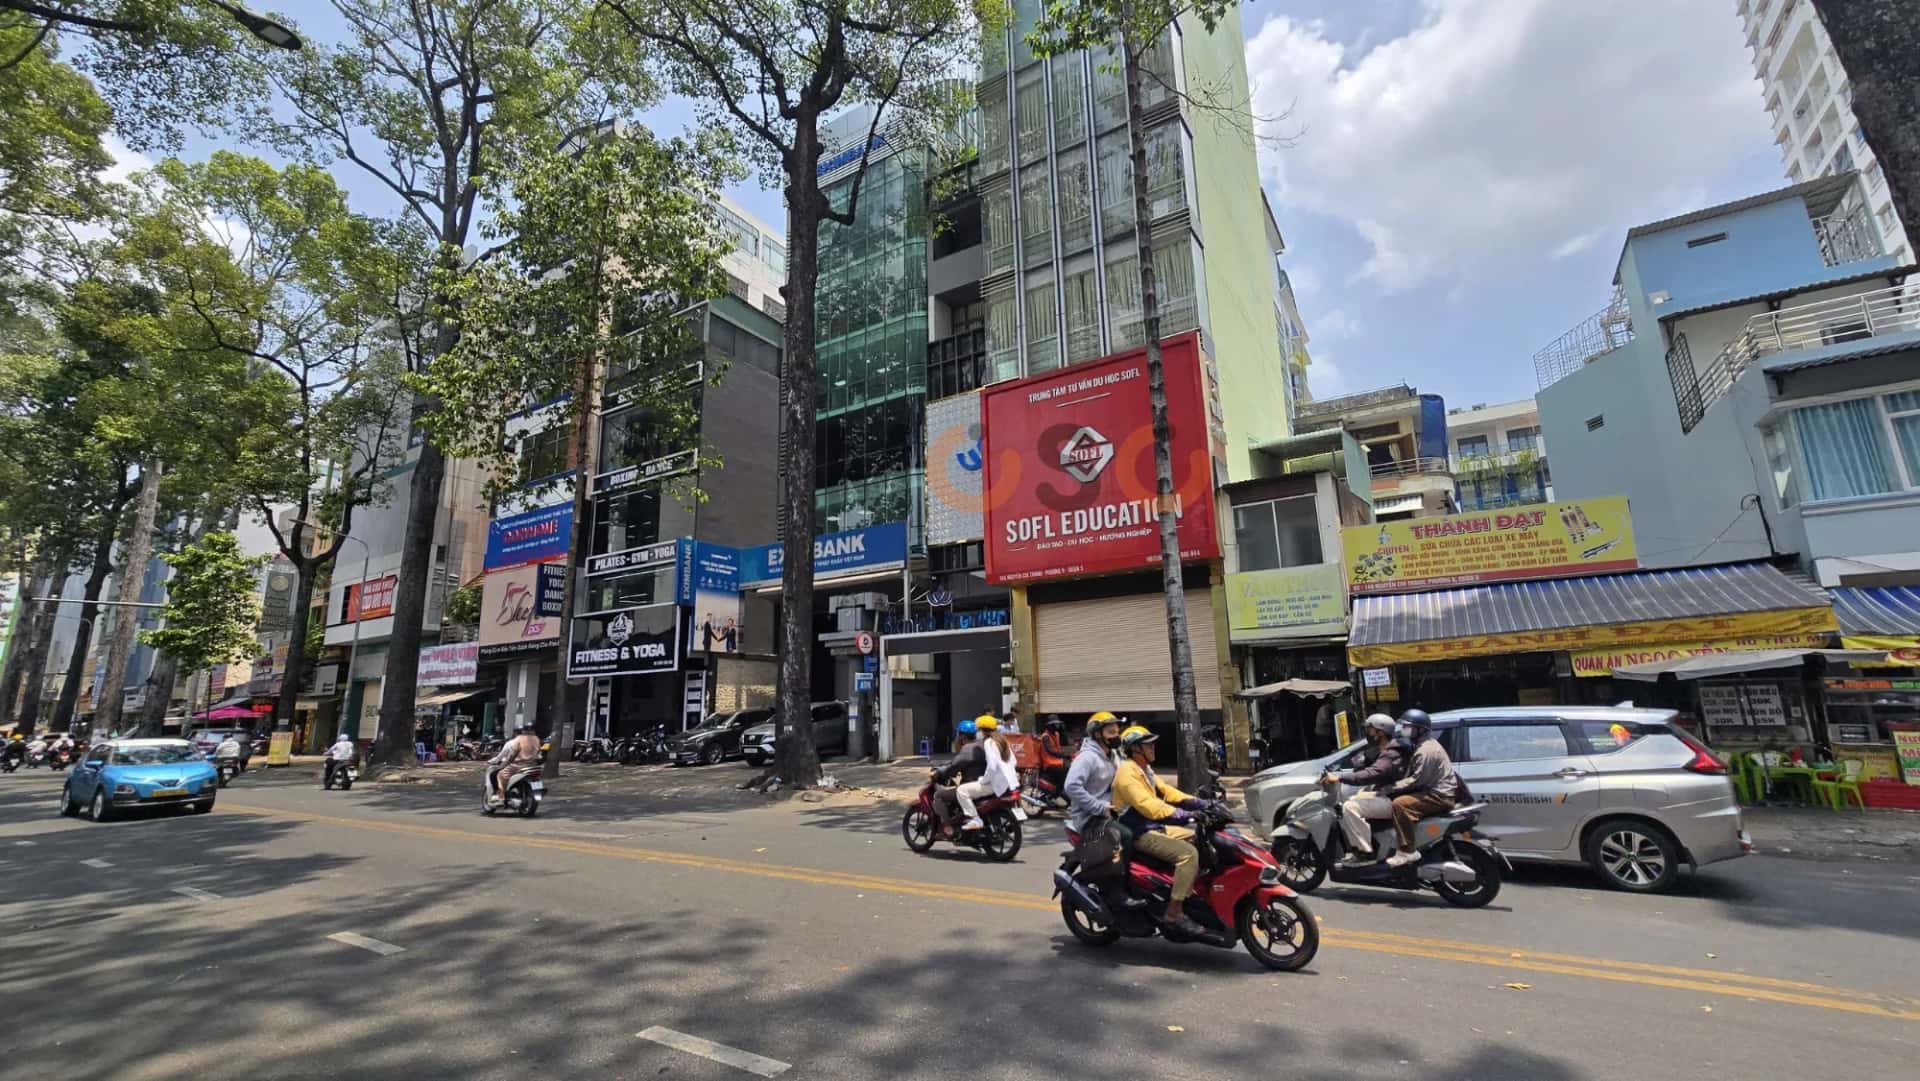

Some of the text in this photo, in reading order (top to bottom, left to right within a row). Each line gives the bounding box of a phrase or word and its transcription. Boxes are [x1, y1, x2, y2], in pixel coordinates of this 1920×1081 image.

[1029, 391, 1051, 403] TRUNG
[1093, 377, 1104, 388] DU
[1120, 368, 1140, 380] SOFL
[1006, 514, 1055, 544] SOFL
[1495, 510, 1546, 531] ĐẠT
[1505, 533, 1516, 542] XE
[594, 545, 675, 571] PILATES GYM YOGA
[683, 543, 691, 600] EXIMBANK
[576, 648, 618, 663] FITNESS
[620, 647, 630, 660] &
[632, 643, 666, 659] YOGA
